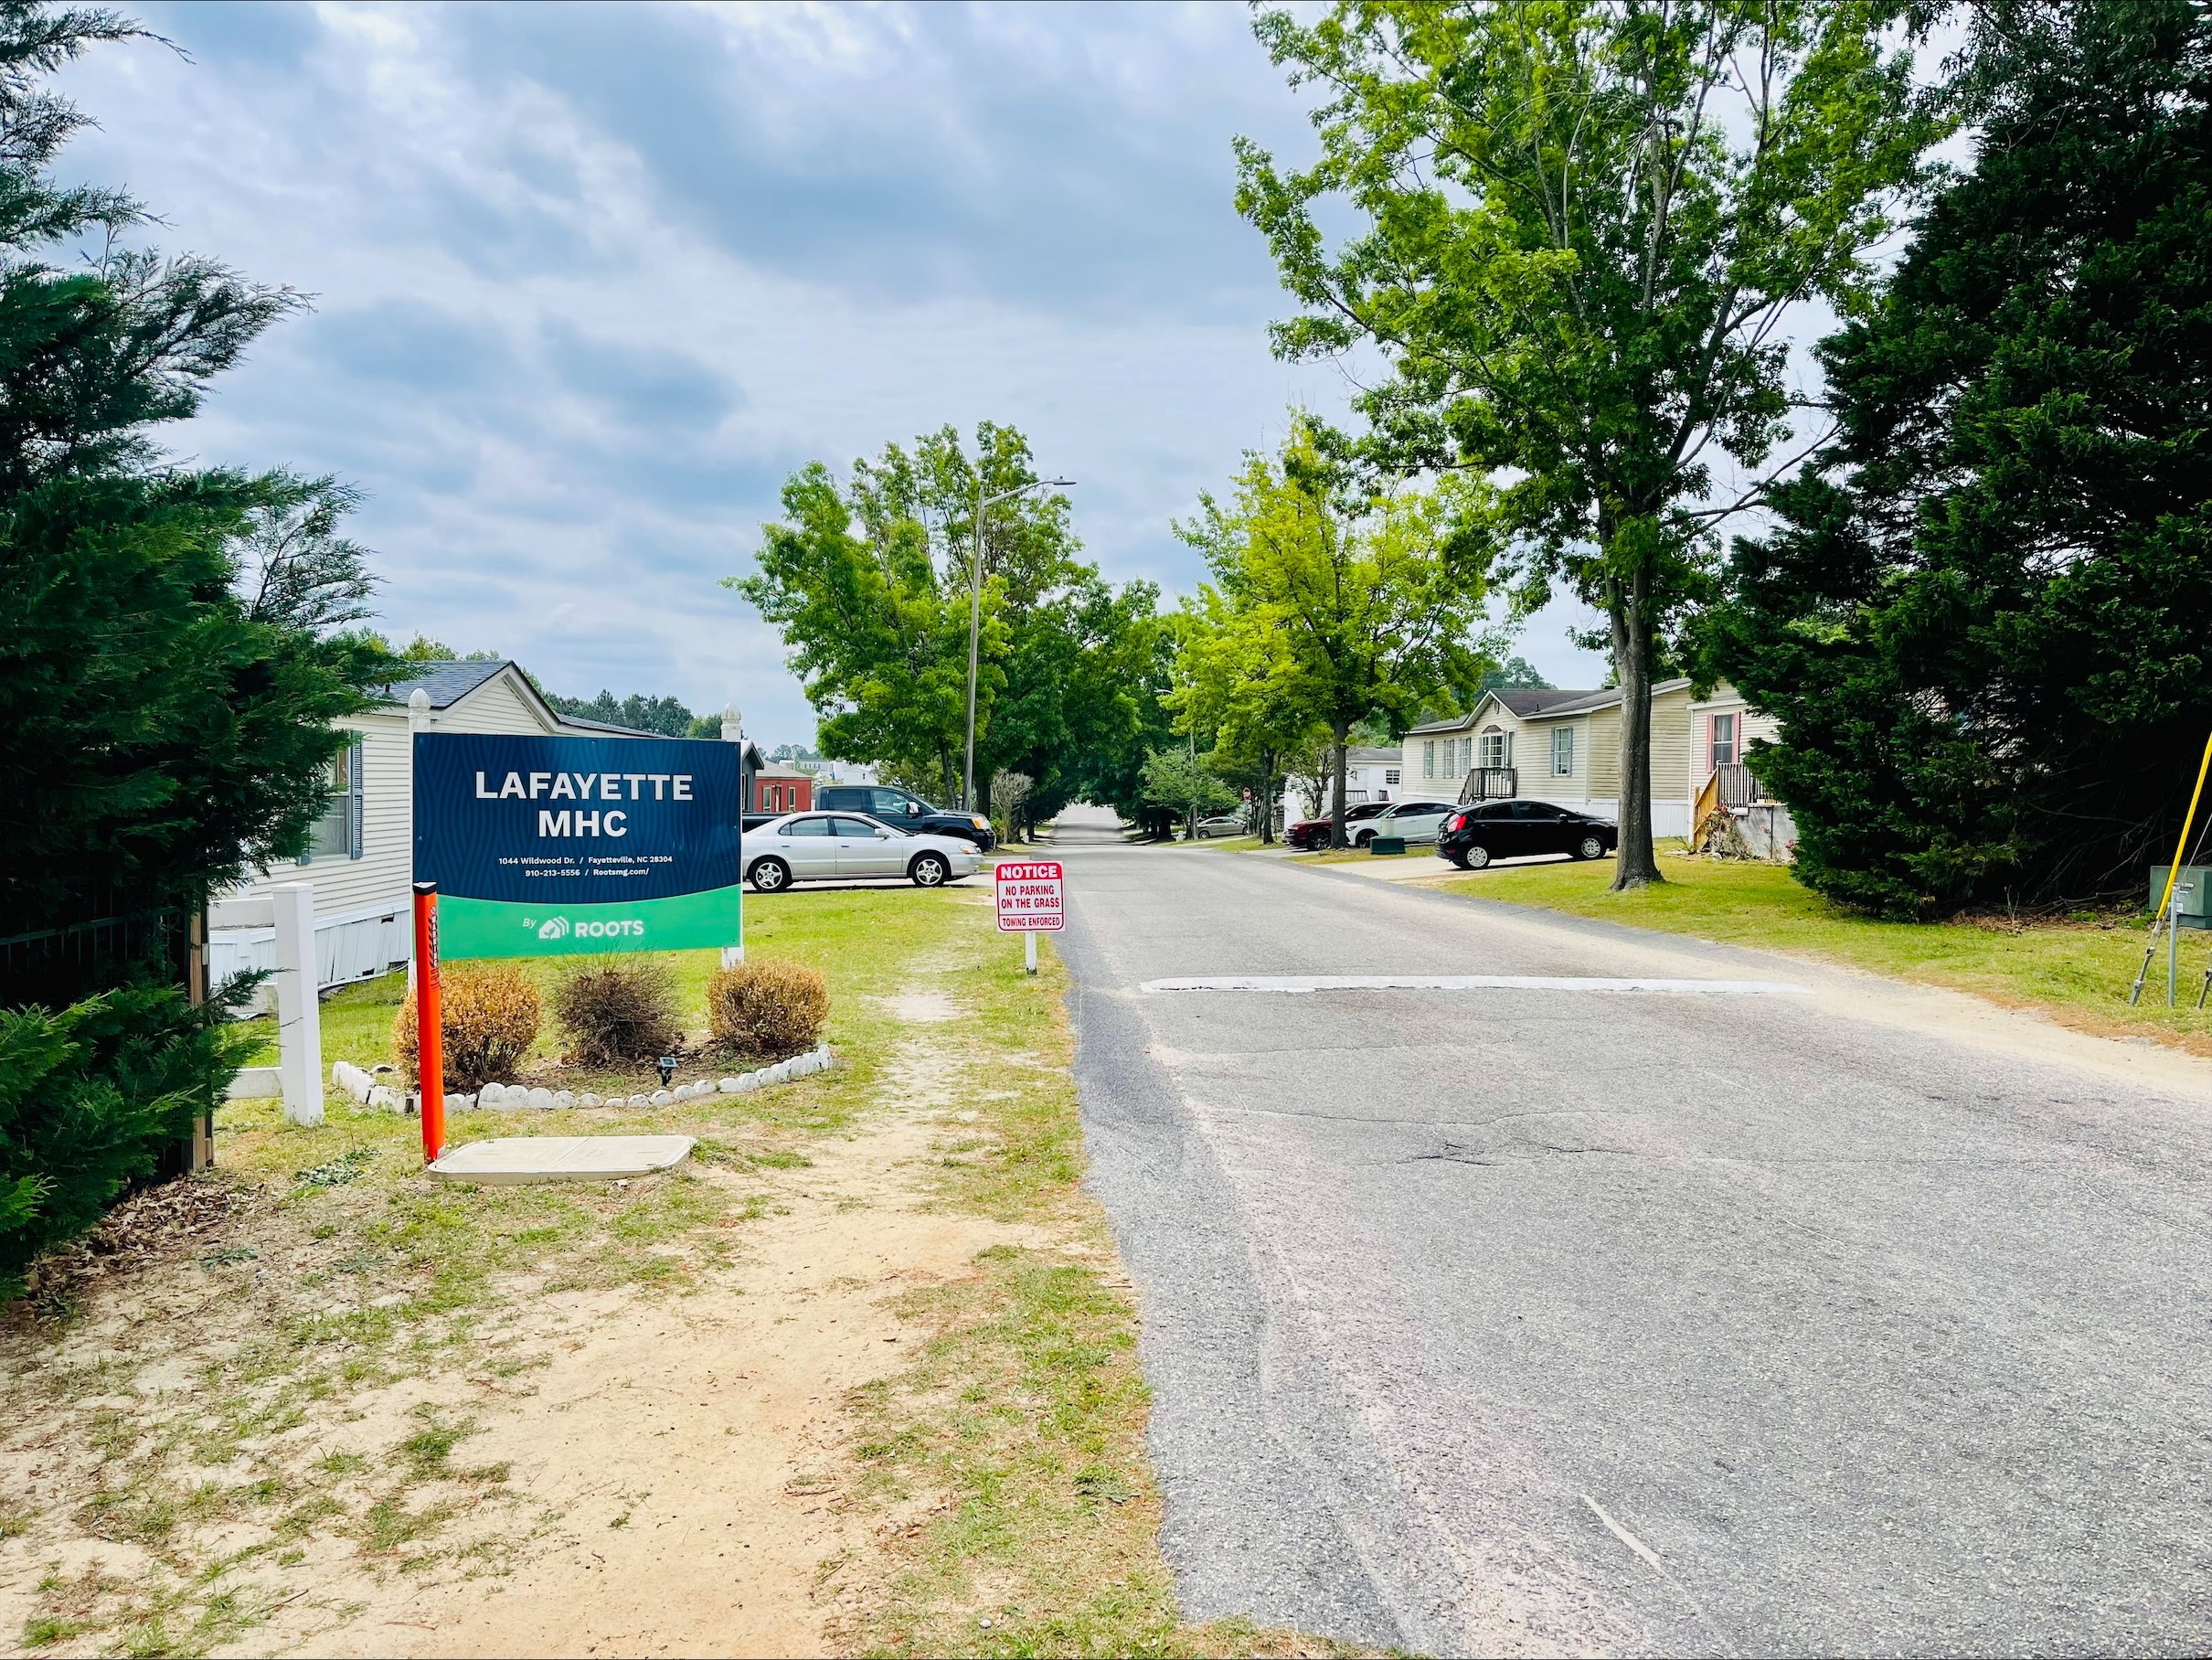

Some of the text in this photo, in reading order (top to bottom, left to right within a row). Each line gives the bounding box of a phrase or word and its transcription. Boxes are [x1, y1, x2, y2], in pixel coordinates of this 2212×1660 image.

[475, 771, 694, 801] LAFAYETTE
[538, 810, 628, 837] MHC
[588, 857, 635, 866] Fayetteville,
[525, 869, 580, 878] 910-213-5556
[593, 867, 649, 877] Rootsmg.com/
[1001, 865, 1058, 878] NOTICE
[1005, 885, 1054, 896] NO PARKING
[1001, 898, 1059, 909] ON THE GRASS
[1002, 917, 1060, 927] TOWING ENFORCED
[522, 918, 644, 938] By ROOTS
